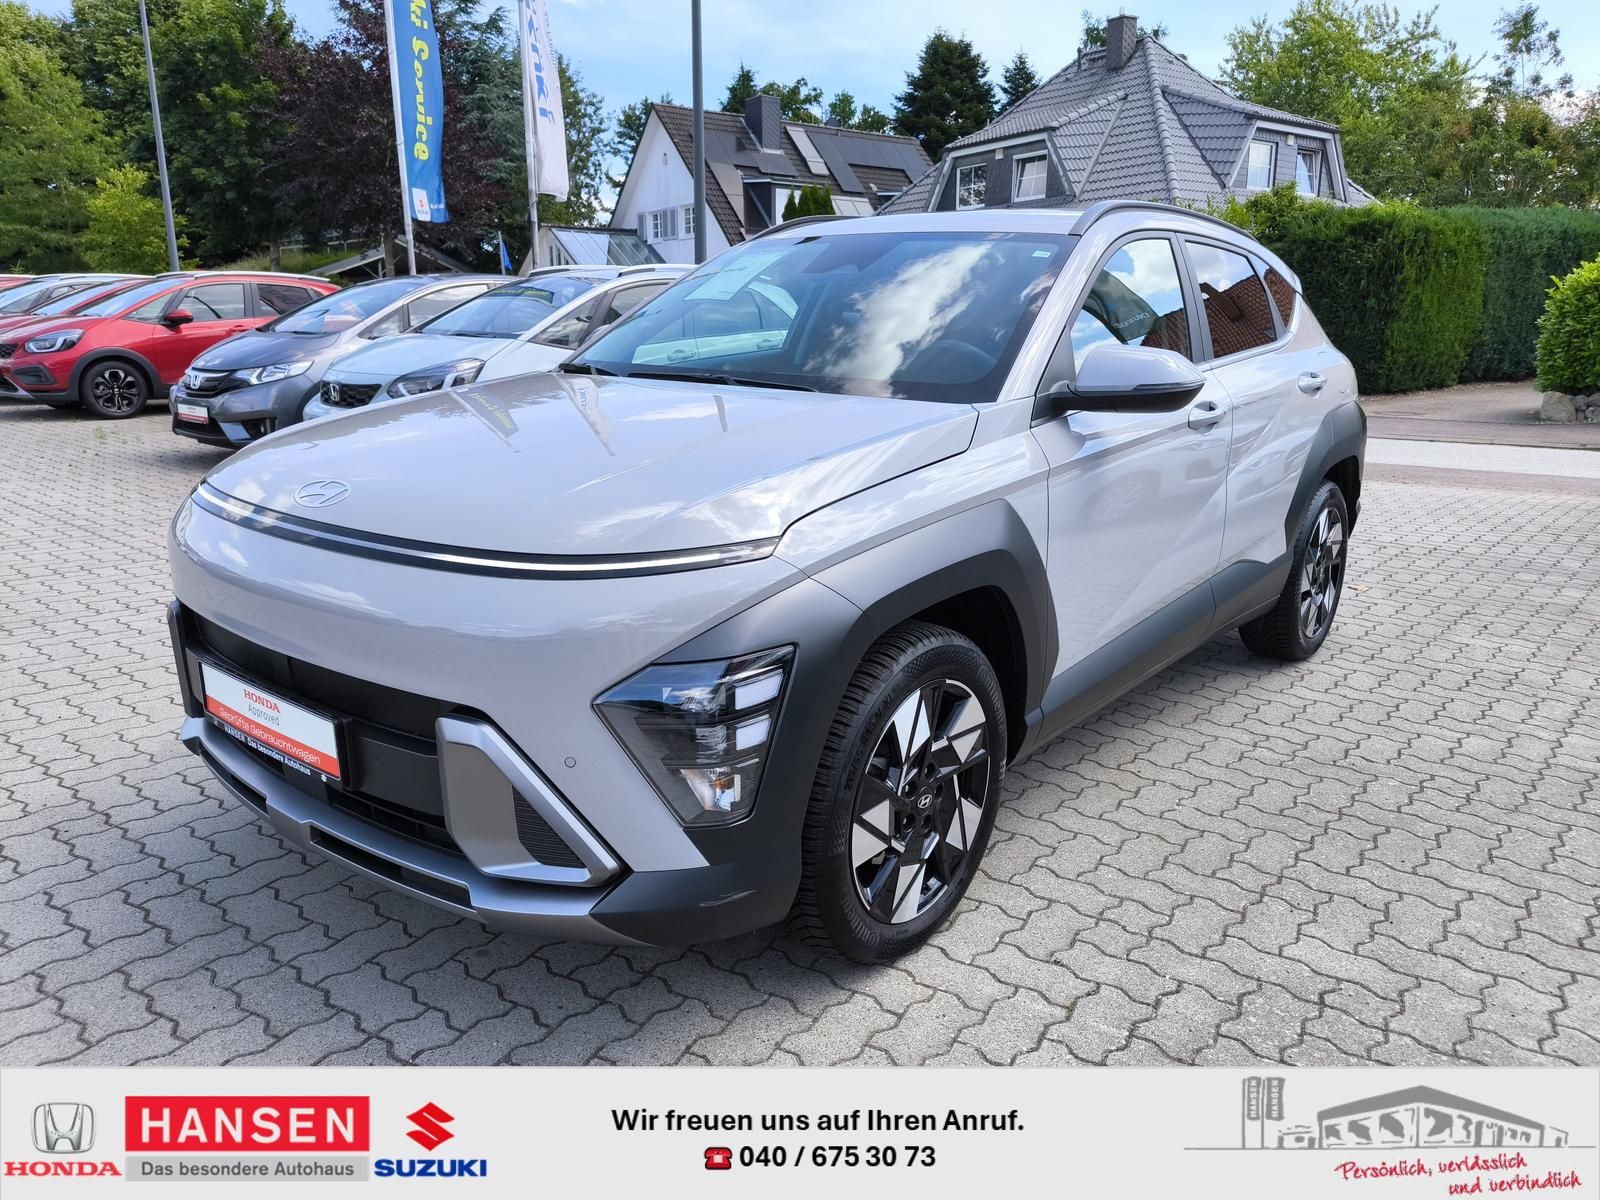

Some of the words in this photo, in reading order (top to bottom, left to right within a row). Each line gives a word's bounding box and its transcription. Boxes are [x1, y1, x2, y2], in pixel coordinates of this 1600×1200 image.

[412, 36, 433, 162] Service
[243, 689, 281, 713] HONDA
[247, 703, 280, 726] Approved
[219, 707, 251, 732] Geprüfte
[250, 724, 321, 766] Gebrauchtwagen
[224, 726, 246, 743] HANSEN
[247, 737, 258, 750] Das
[284, 756, 311, 776] Autohaus
